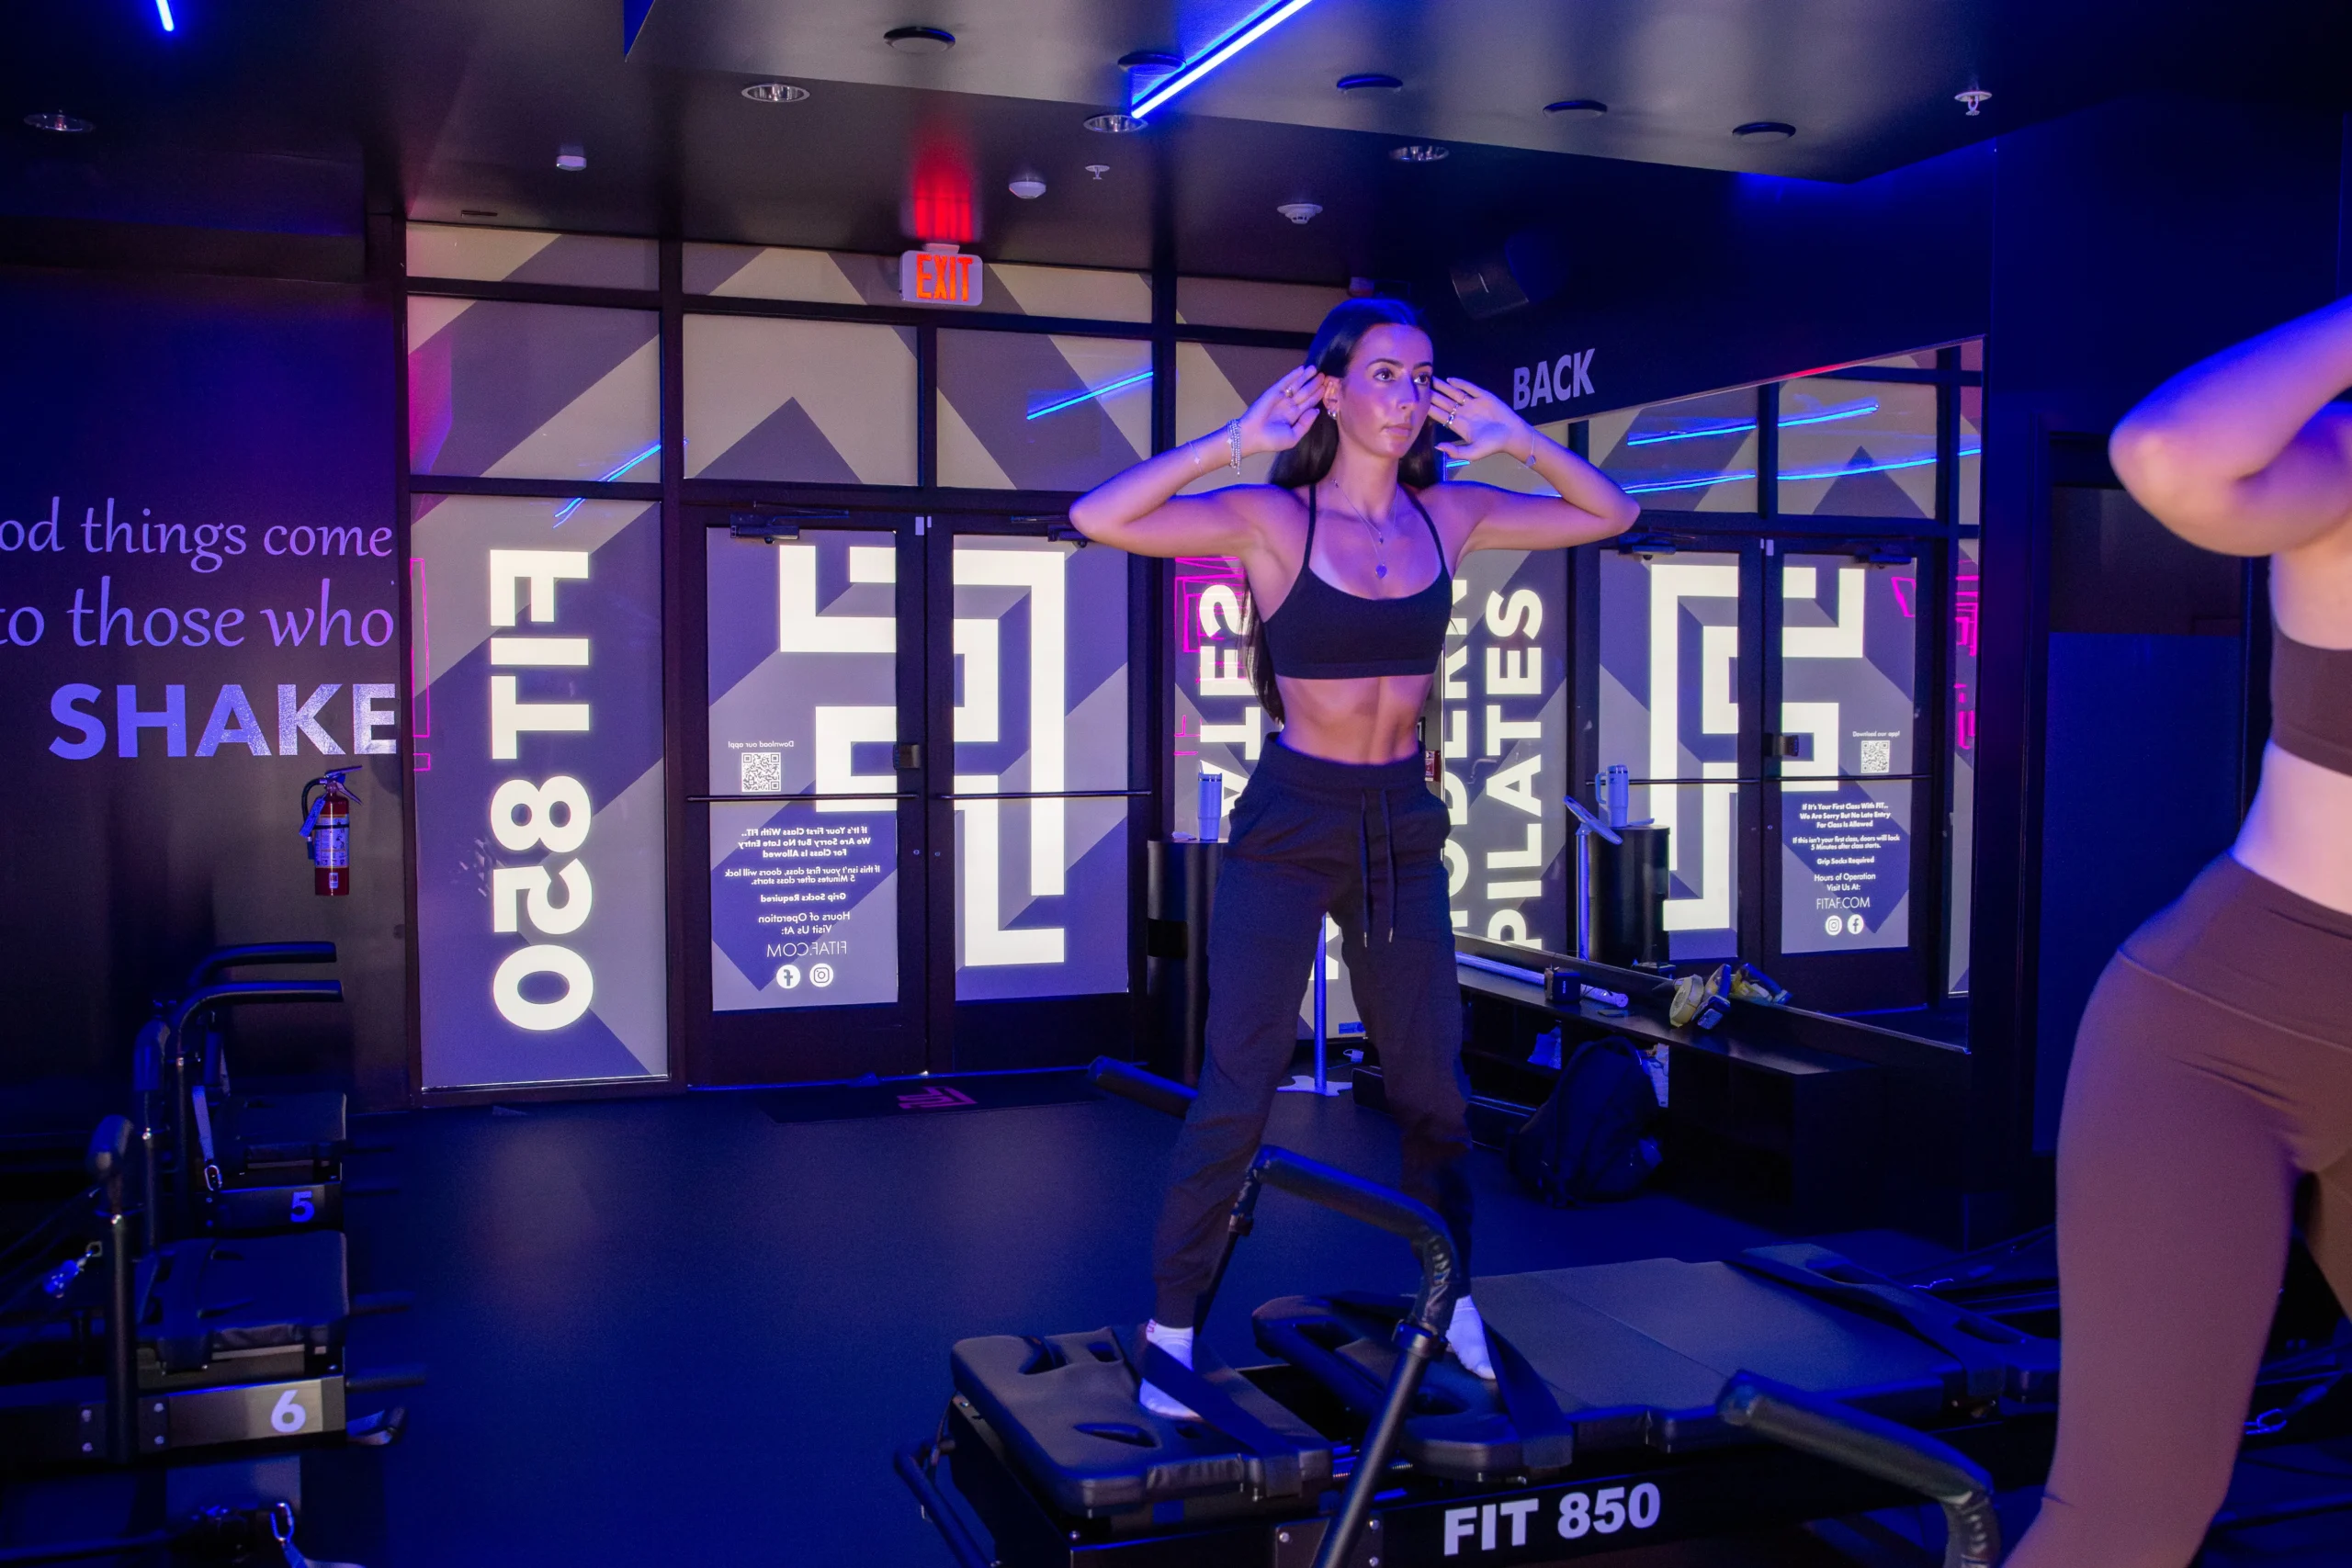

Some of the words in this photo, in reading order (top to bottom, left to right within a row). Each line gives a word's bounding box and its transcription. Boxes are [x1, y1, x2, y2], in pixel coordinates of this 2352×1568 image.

[916, 254, 973, 302] EXIT
[1513, 348, 1595, 411] BACK
[81, 497, 246, 573] things
[264, 525, 392, 557] come
[0, 604, 45, 647] o
[67, 575, 244, 647] those
[260, 578, 394, 647] who
[48, 683, 397, 760] SHAKE
[1485, 588, 1543, 950] PILATES
[1843, 873, 1875, 882] Operation
[1849, 856, 1874, 864] Required
[1816, 897, 1870, 909] FITAF.COM
[290, 1190, 315, 1223] 5
[271, 1389, 306, 1433] 6
[1443, 1498, 1539, 1556] FIT
[1557, 1483, 1661, 1539] 850
